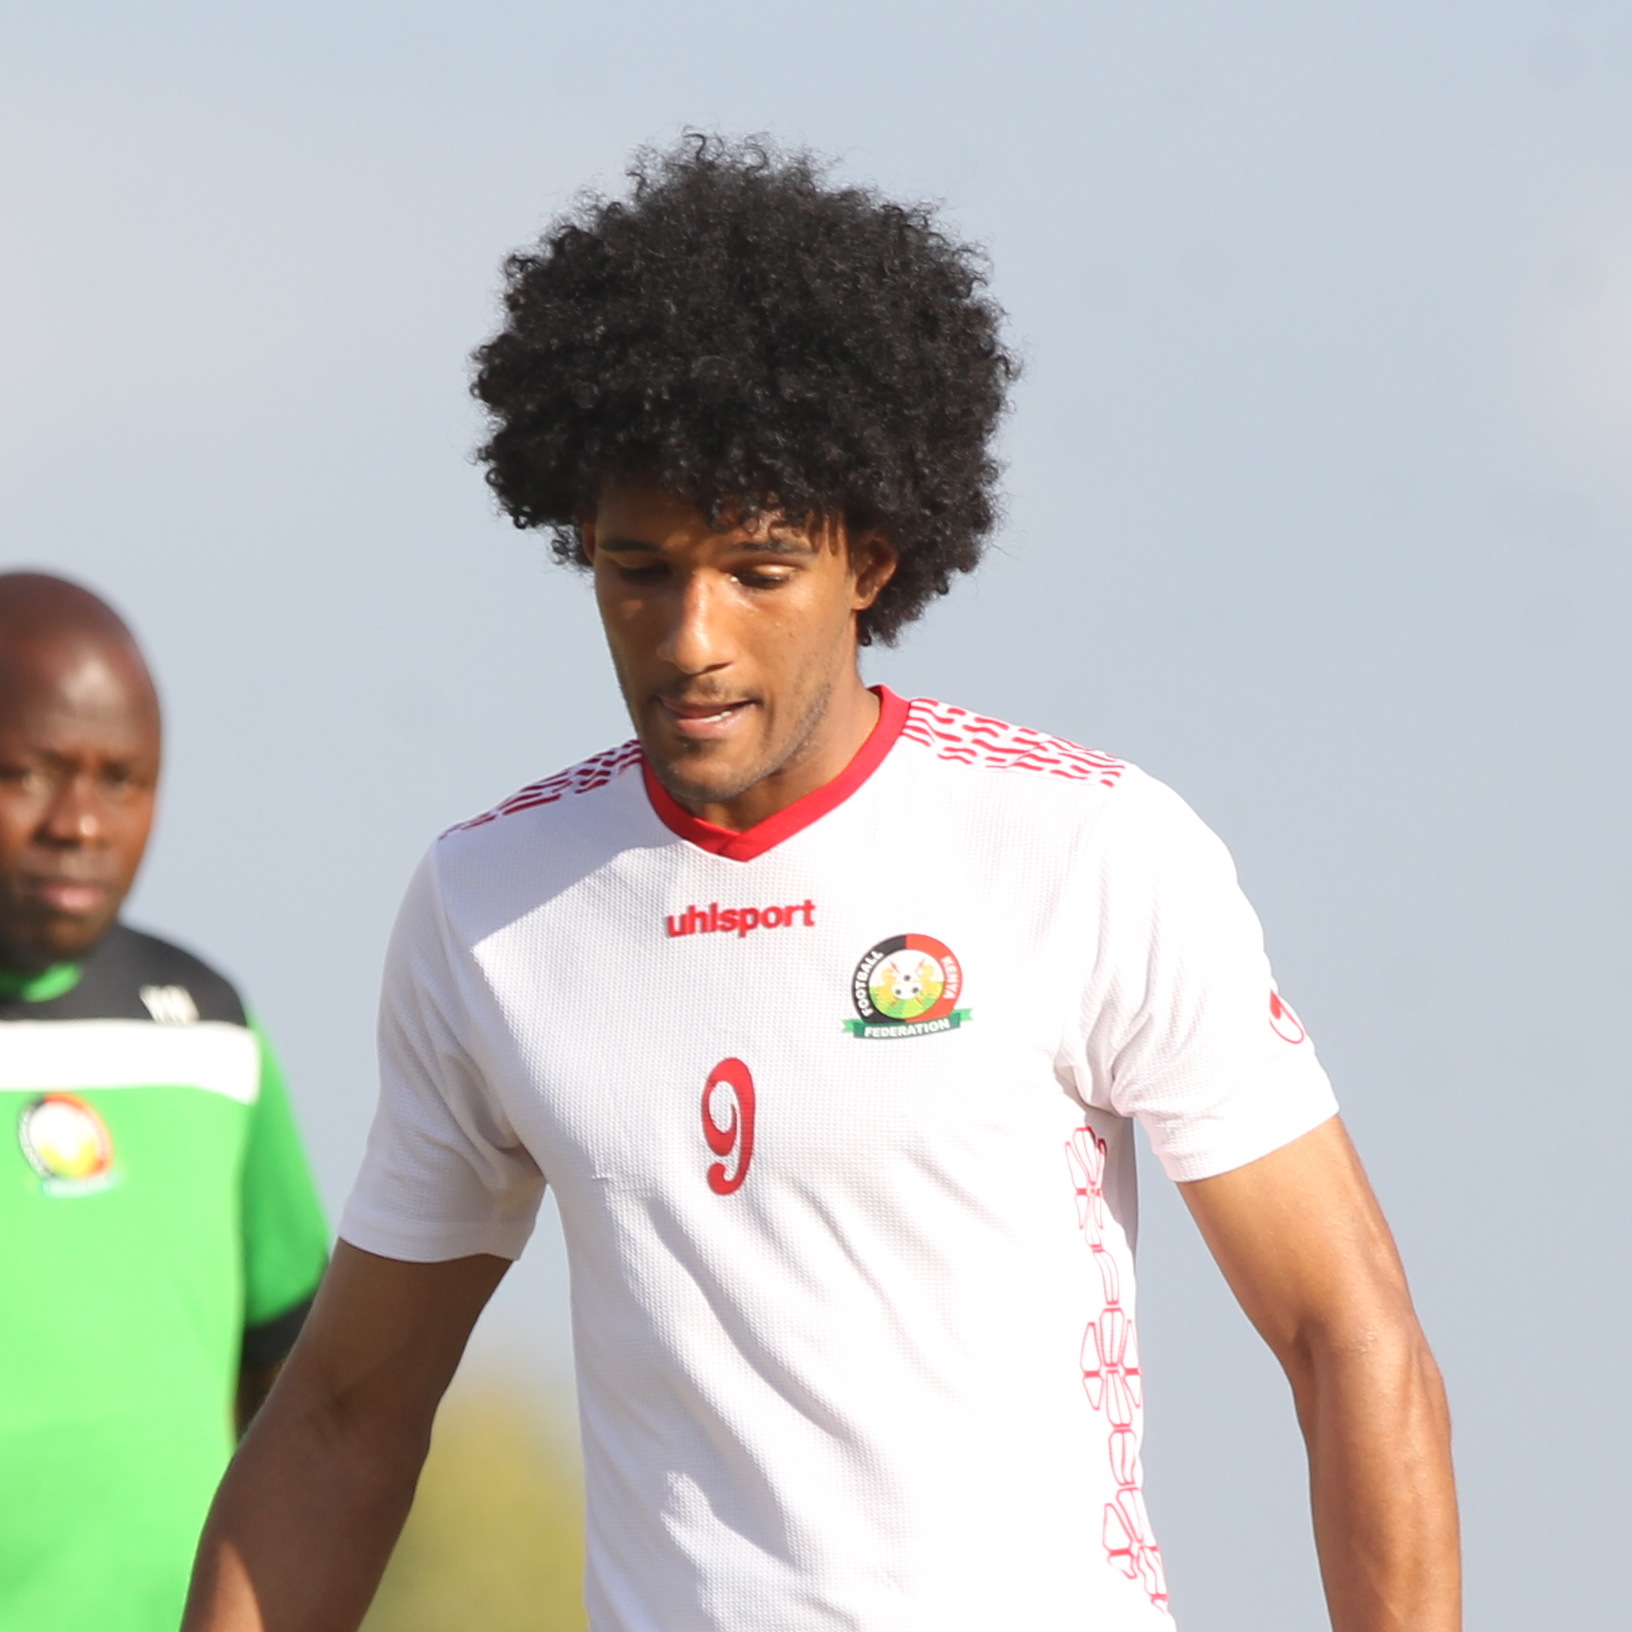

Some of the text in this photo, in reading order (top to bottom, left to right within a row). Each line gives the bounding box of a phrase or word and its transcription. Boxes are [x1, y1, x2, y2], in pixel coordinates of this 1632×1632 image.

[666, 899, 816, 938] uhlsport
[855, 950, 884, 1017] FOOTBALL
[941, 955, 959, 999] KENYA
[864, 1018, 950, 1038] FEDERATION
[701, 1057, 756, 1195] 9
